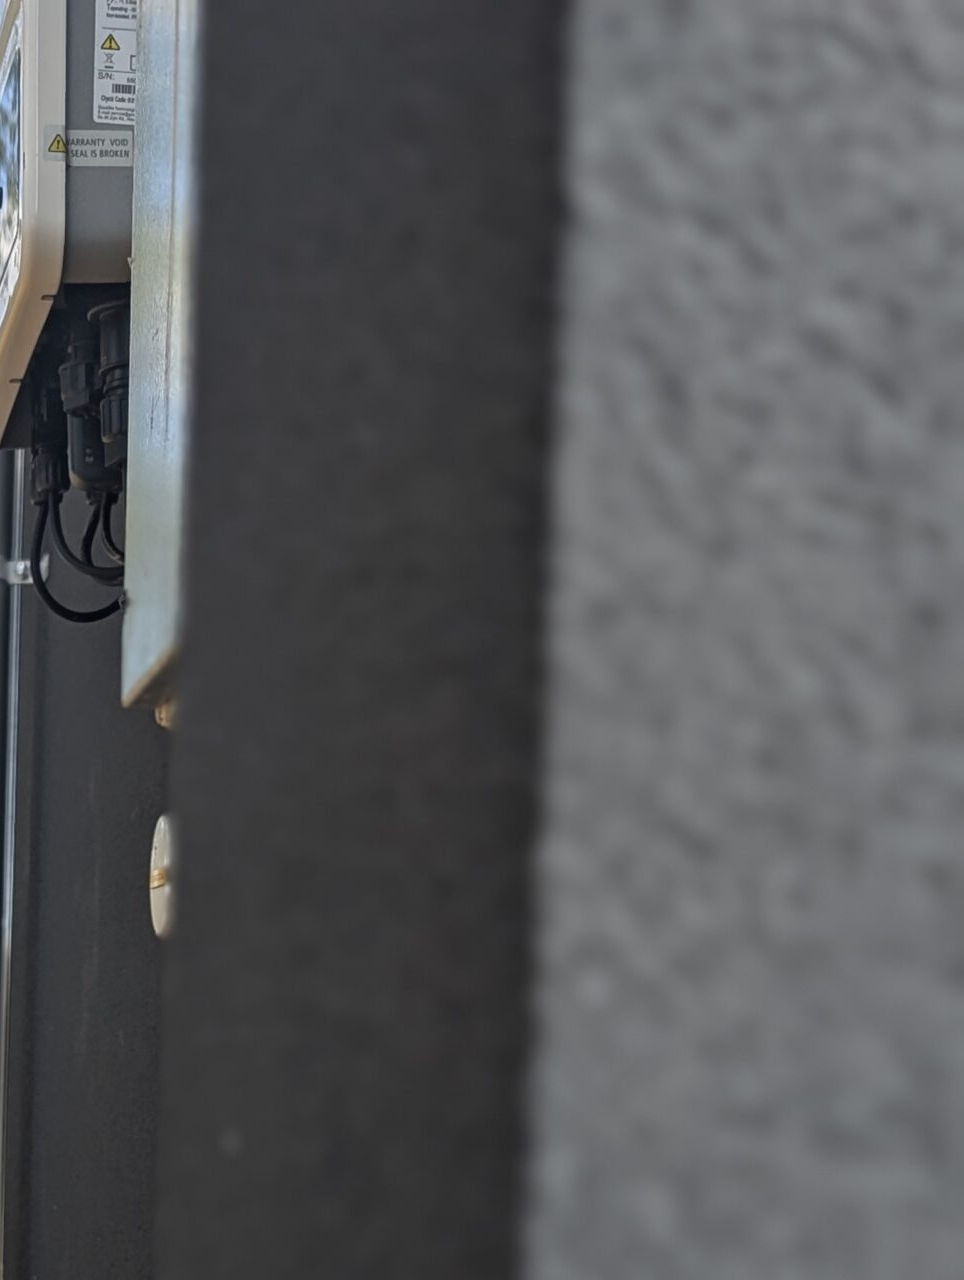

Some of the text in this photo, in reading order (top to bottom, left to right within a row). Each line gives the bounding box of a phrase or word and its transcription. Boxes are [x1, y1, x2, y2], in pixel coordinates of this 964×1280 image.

[110, 138, 129, 147] VOID
[70, 149, 130, 158] SEAL IS BROKEN
